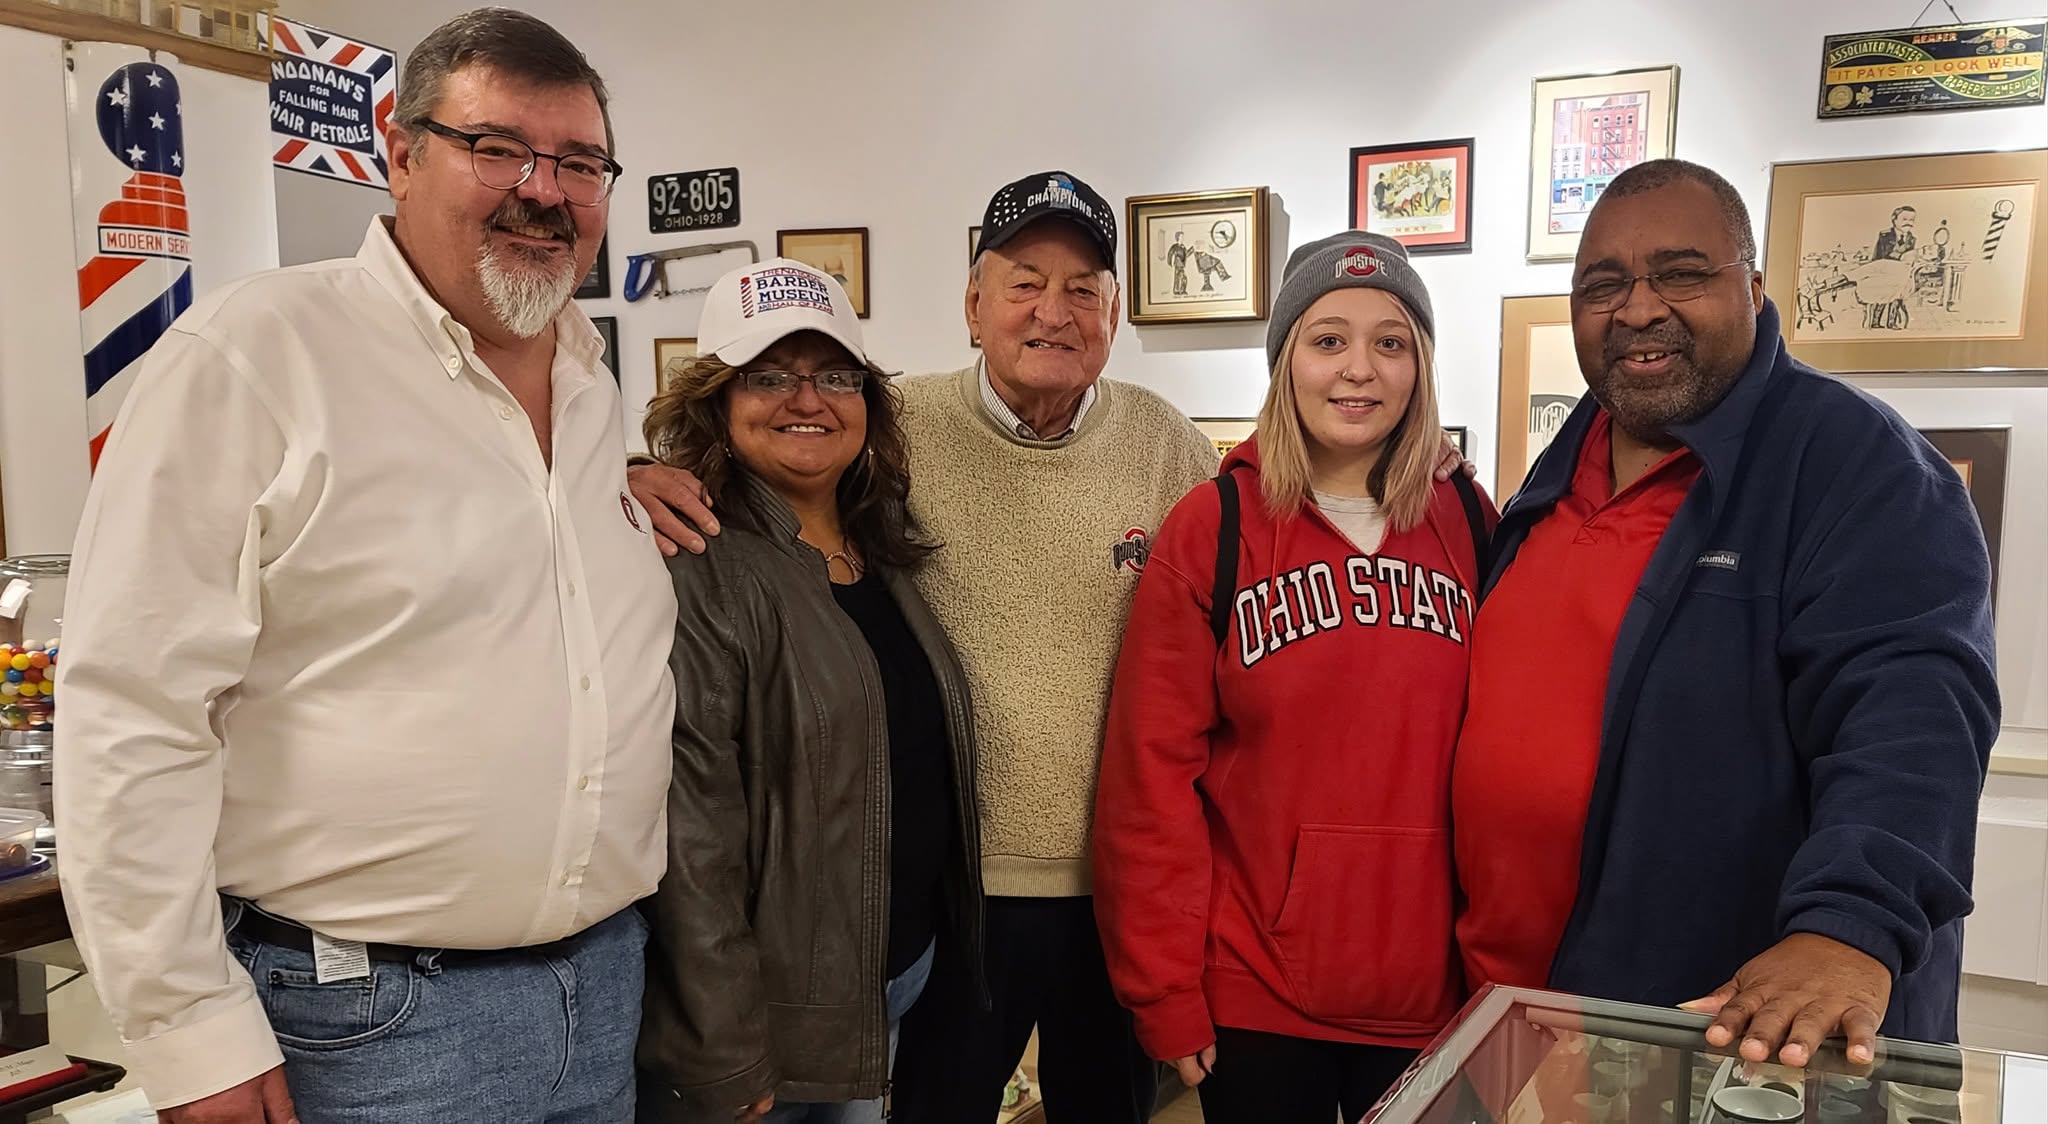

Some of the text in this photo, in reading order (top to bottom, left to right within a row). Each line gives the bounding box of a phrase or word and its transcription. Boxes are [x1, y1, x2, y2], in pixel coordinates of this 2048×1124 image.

[1829, 41, 1924, 64] ASSOCIATED MASTER
[1856, 66, 1897, 79] PAYS
[1903, 65, 1925, 76] TO
[1934, 59, 1980, 73] LOOK
[271, 60, 366, 103] NOONAN'S
[309, 84, 330, 97] FOR
[1943, 75, 1986, 97] BARBERS
[1994, 75, 2039, 96] AMERICA
[279, 89, 360, 122] FALLING HAIR
[271, 100, 372, 144] HAIR PETROLE
[652, 175, 734, 216] 92-805
[1027, 187, 1092, 218] CHAMPIONS
[107, 231, 163, 251] MODERN
[1335, 253, 1388, 279] OHIO STATE
[756, 276, 829, 296] BARBER
[759, 288, 833, 308] MUSEUM
[772, 301, 793, 309] HALL
[1696, 553, 1736, 566] olumbia
[1235, 561, 1342, 669] OHIO
